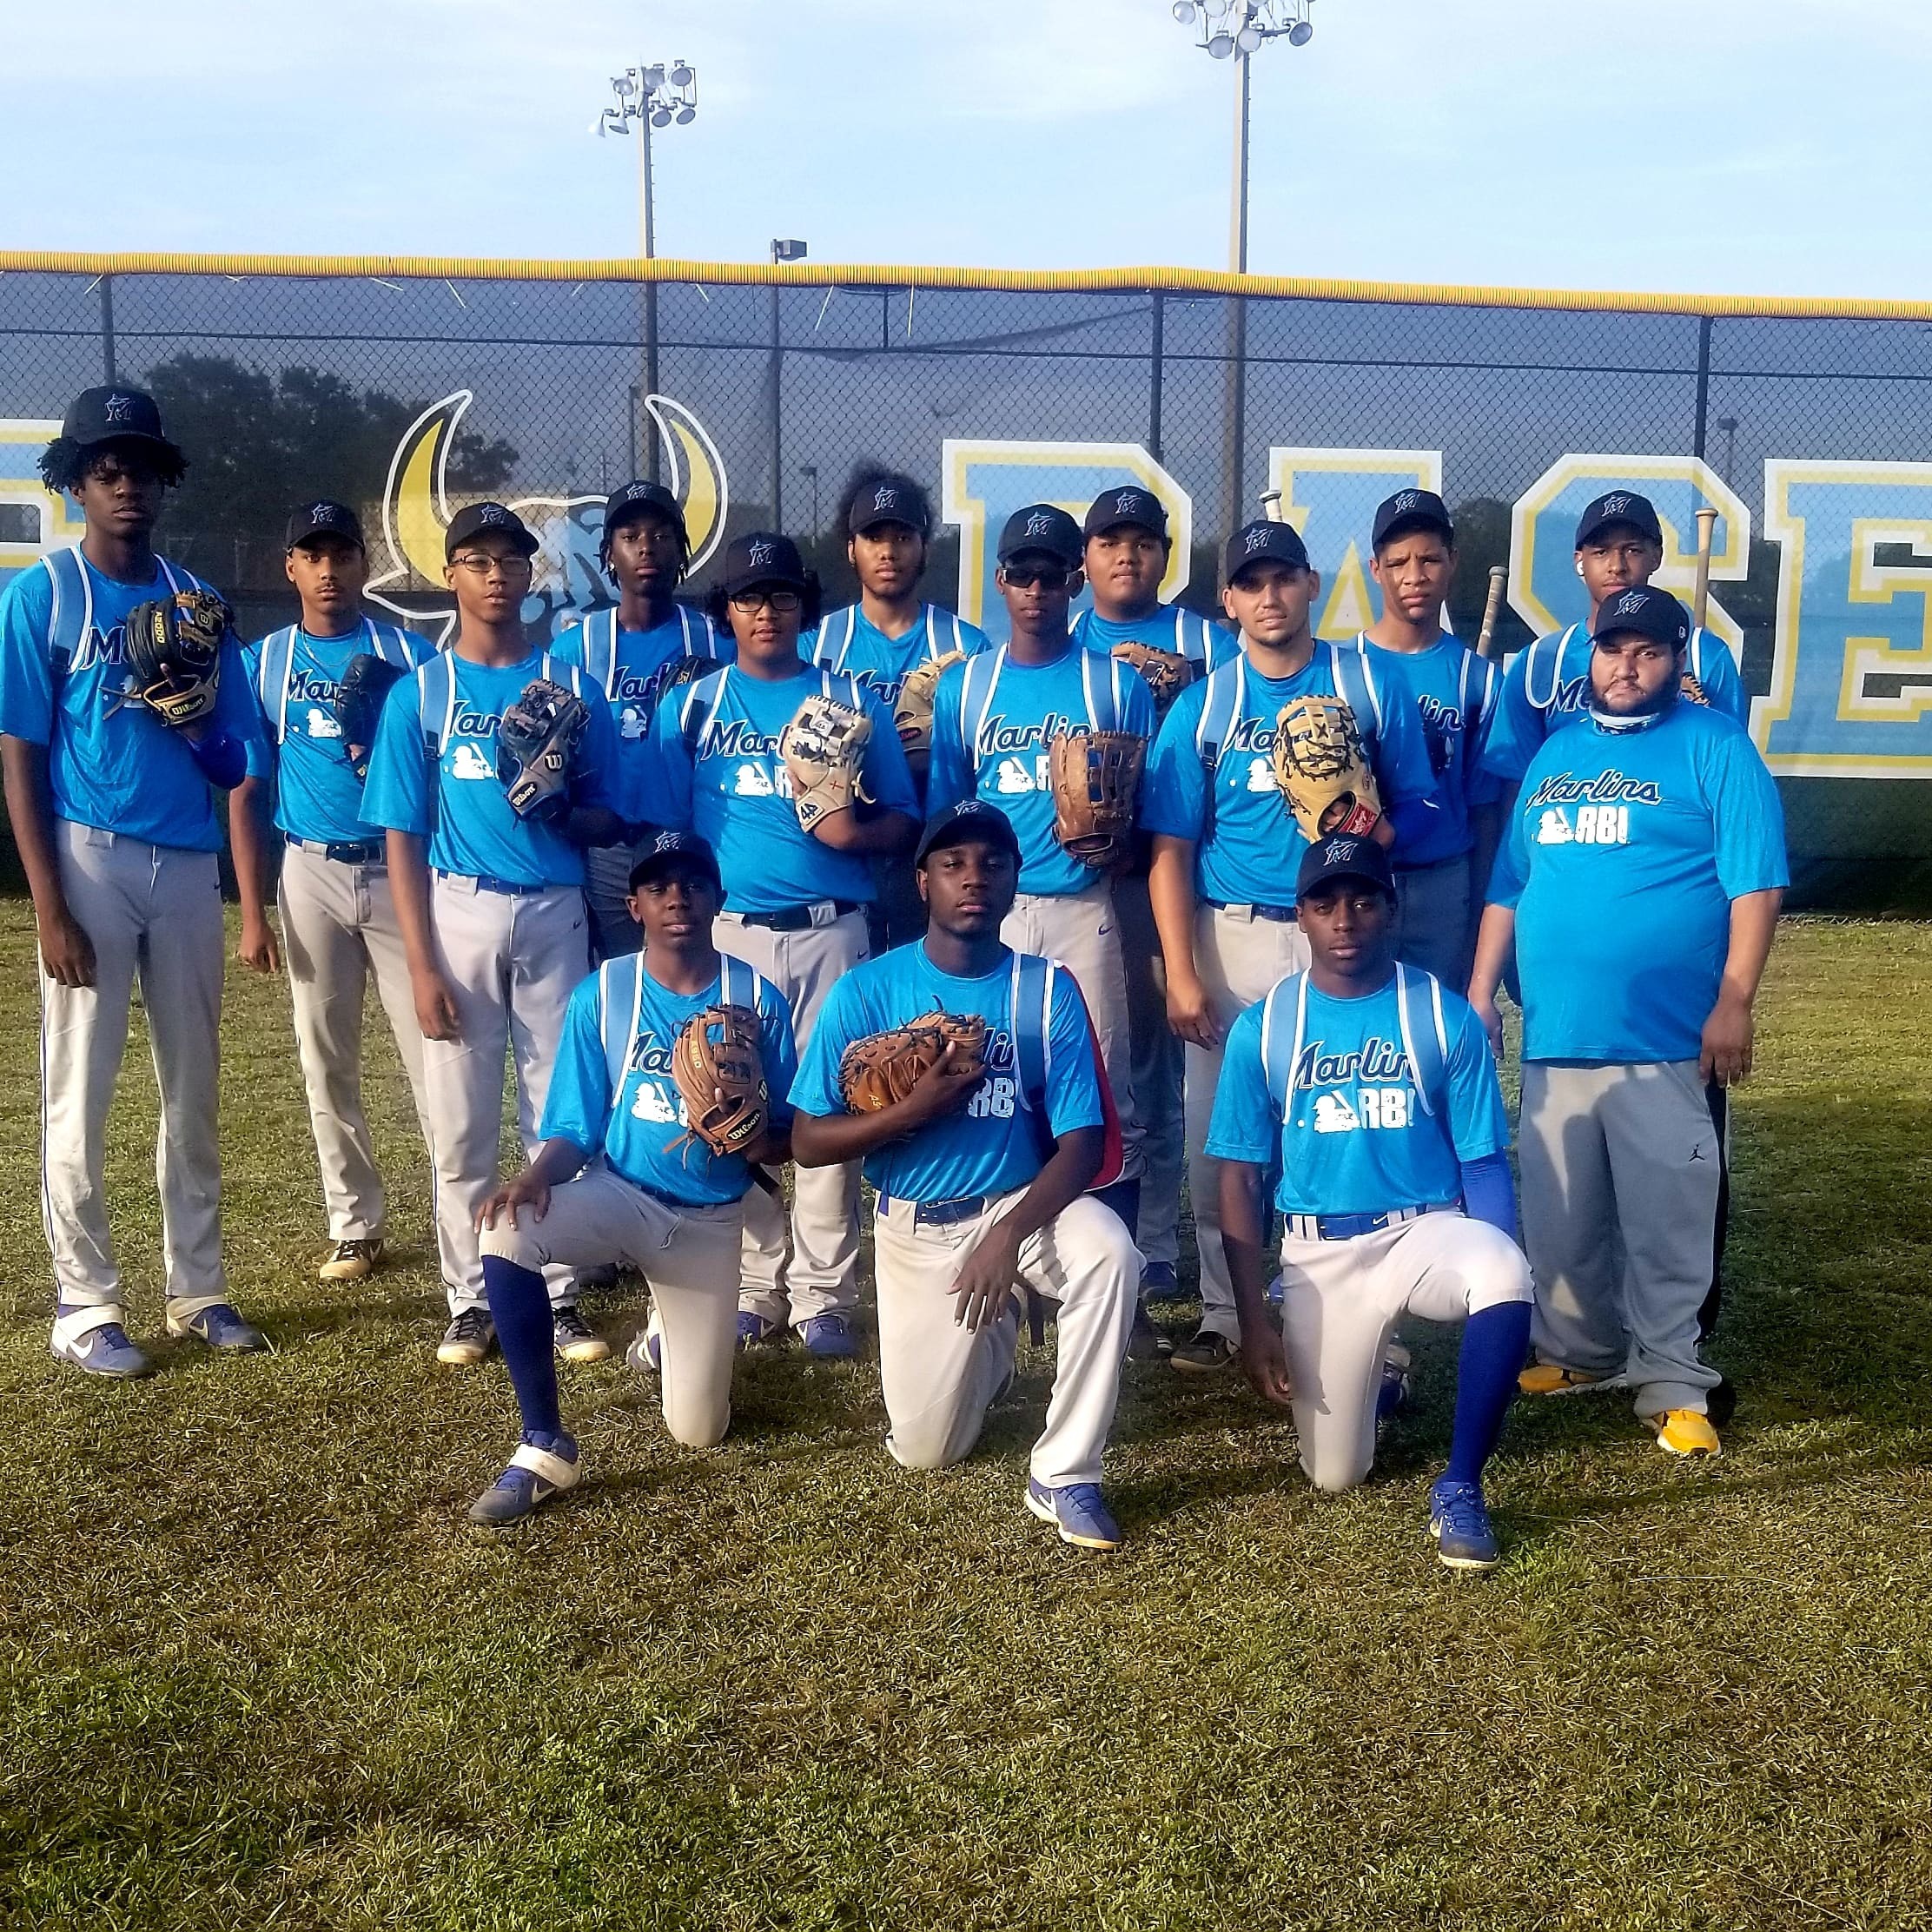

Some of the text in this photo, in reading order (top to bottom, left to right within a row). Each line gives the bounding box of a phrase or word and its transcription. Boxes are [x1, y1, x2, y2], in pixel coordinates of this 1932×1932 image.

[1525, 769, 1663, 811] Marlins
[800, 803, 818, 820] 44
[1575, 806, 1629, 844] RBI
[968, 1078, 1019, 1118] RB
[1358, 1088, 1416, 1129] RBI
[728, 1113, 760, 1141] Wilson
